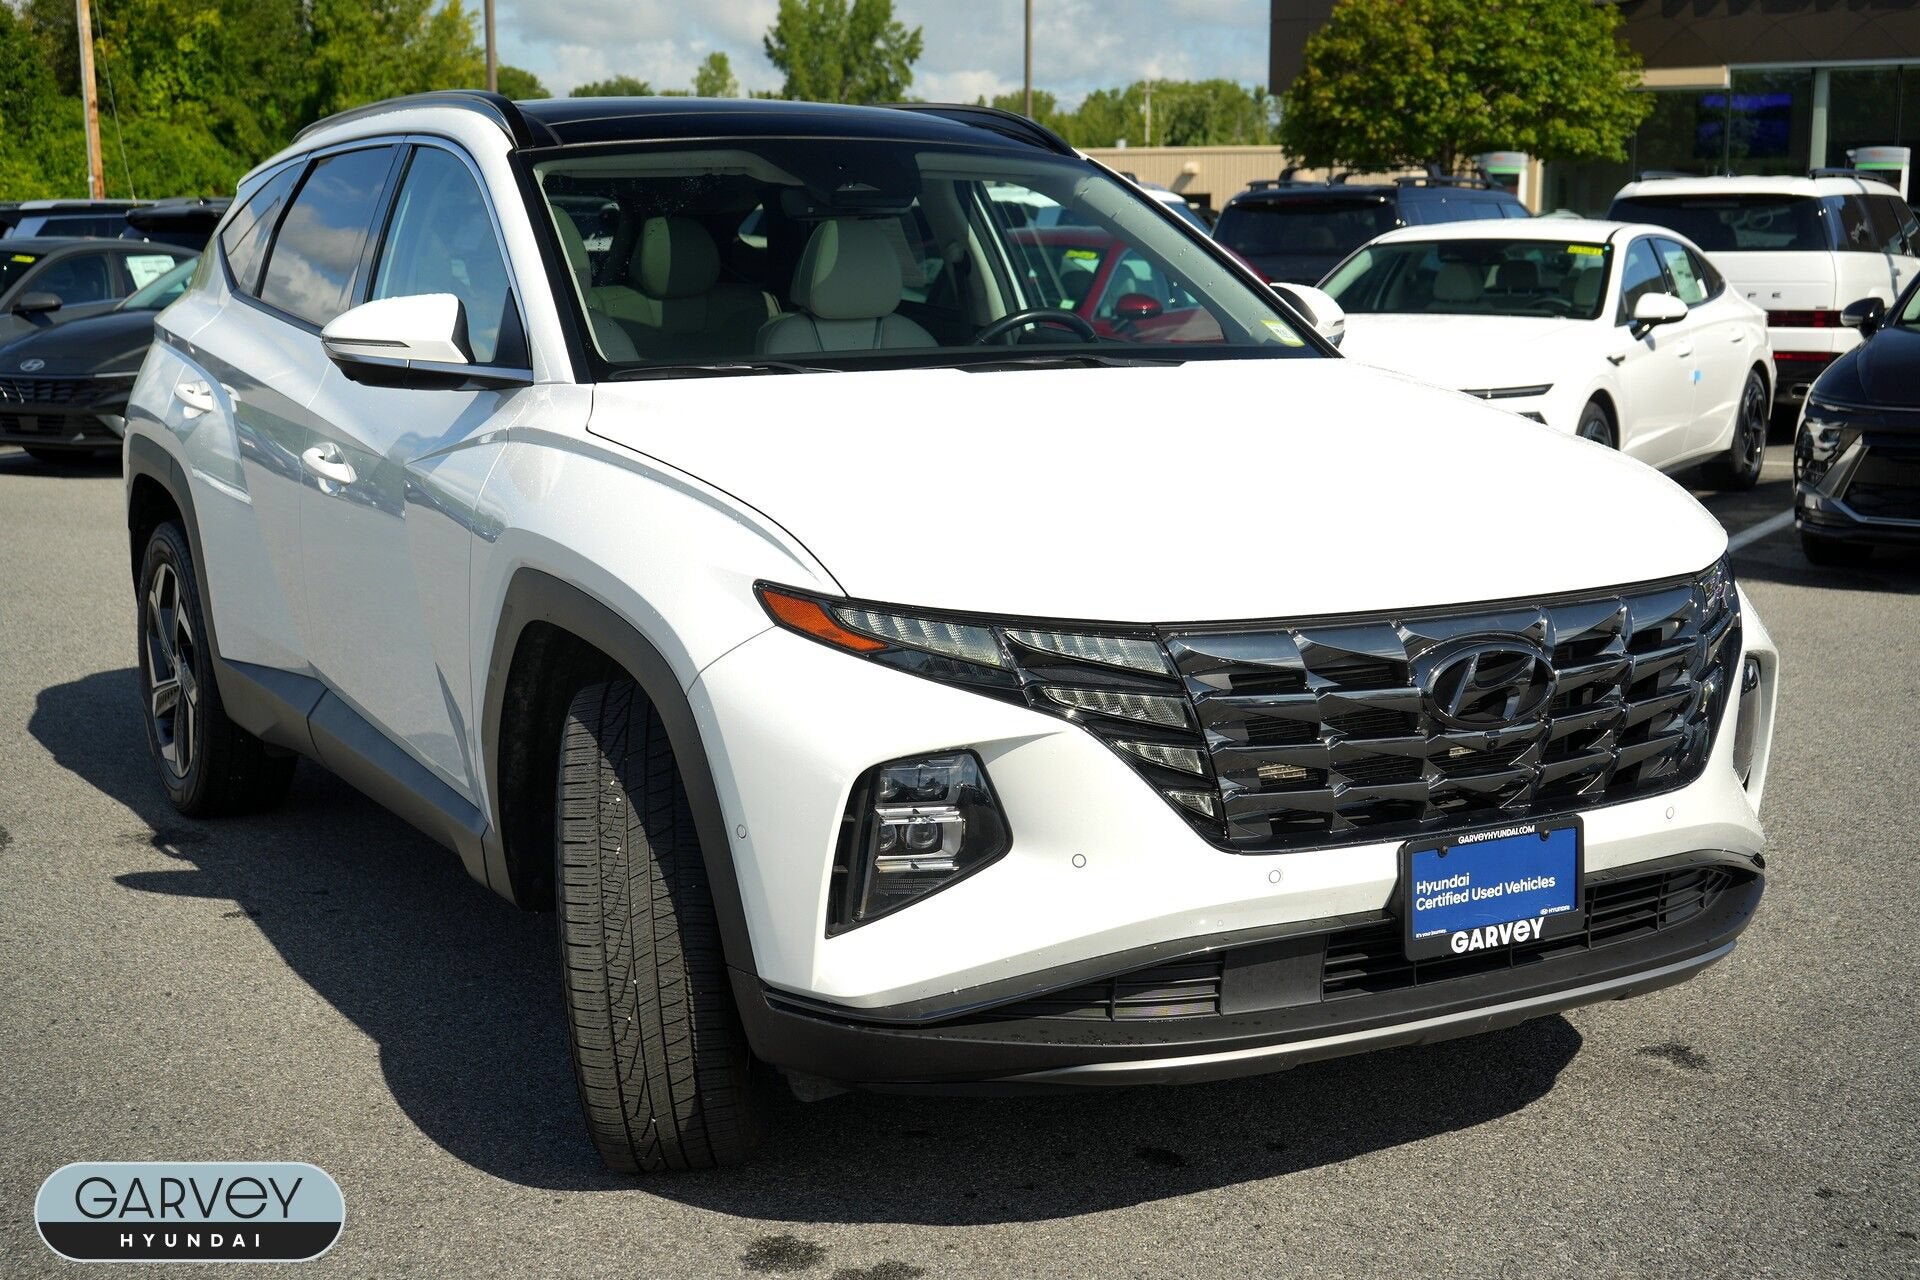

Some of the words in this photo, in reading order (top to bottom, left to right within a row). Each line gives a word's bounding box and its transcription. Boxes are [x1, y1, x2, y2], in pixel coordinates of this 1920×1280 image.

[1416, 873, 1470, 896] Hyundai
[1416, 890, 1469, 911] Certified
[1472, 885, 1502, 901] Used
[1505, 875, 1556, 895] Vehicles
